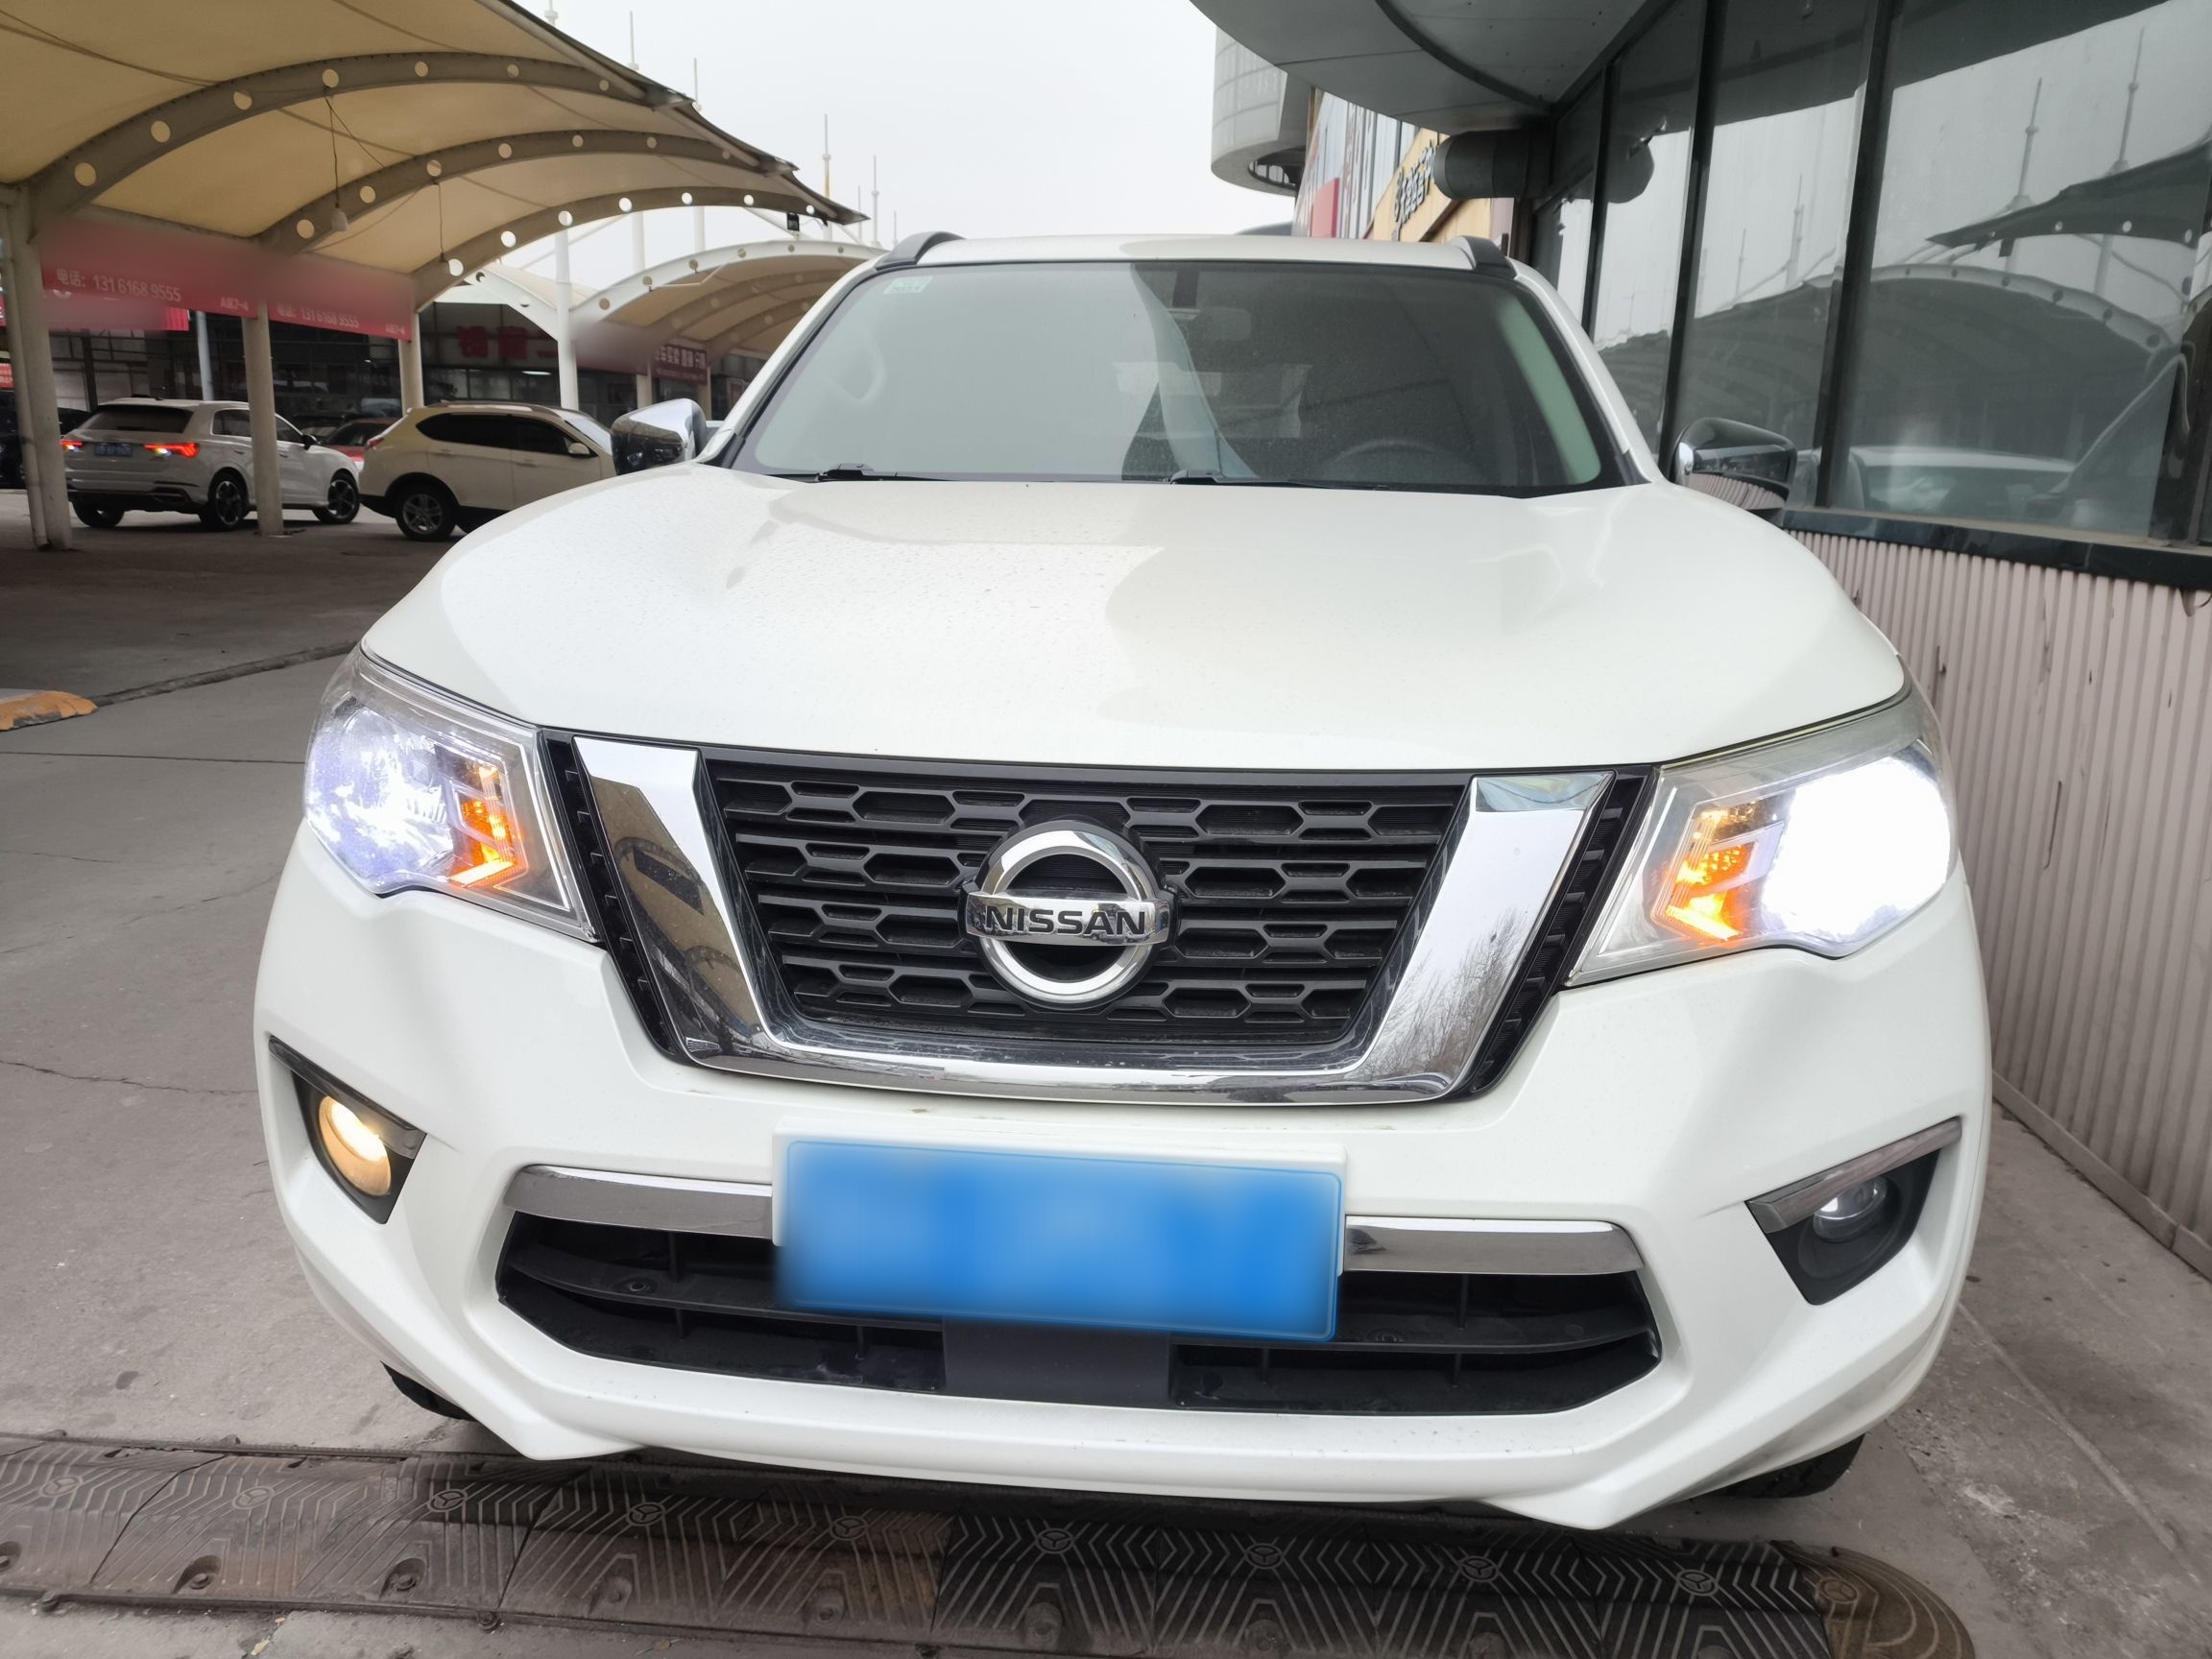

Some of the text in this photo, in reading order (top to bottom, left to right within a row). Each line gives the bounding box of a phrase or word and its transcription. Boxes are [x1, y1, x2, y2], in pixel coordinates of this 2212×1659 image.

[92, 274, 114, 292] 131
[117, 277, 149, 298] 6168
[151, 283, 181, 302] 9555
[986, 905, 1144, 936] NISSAN
